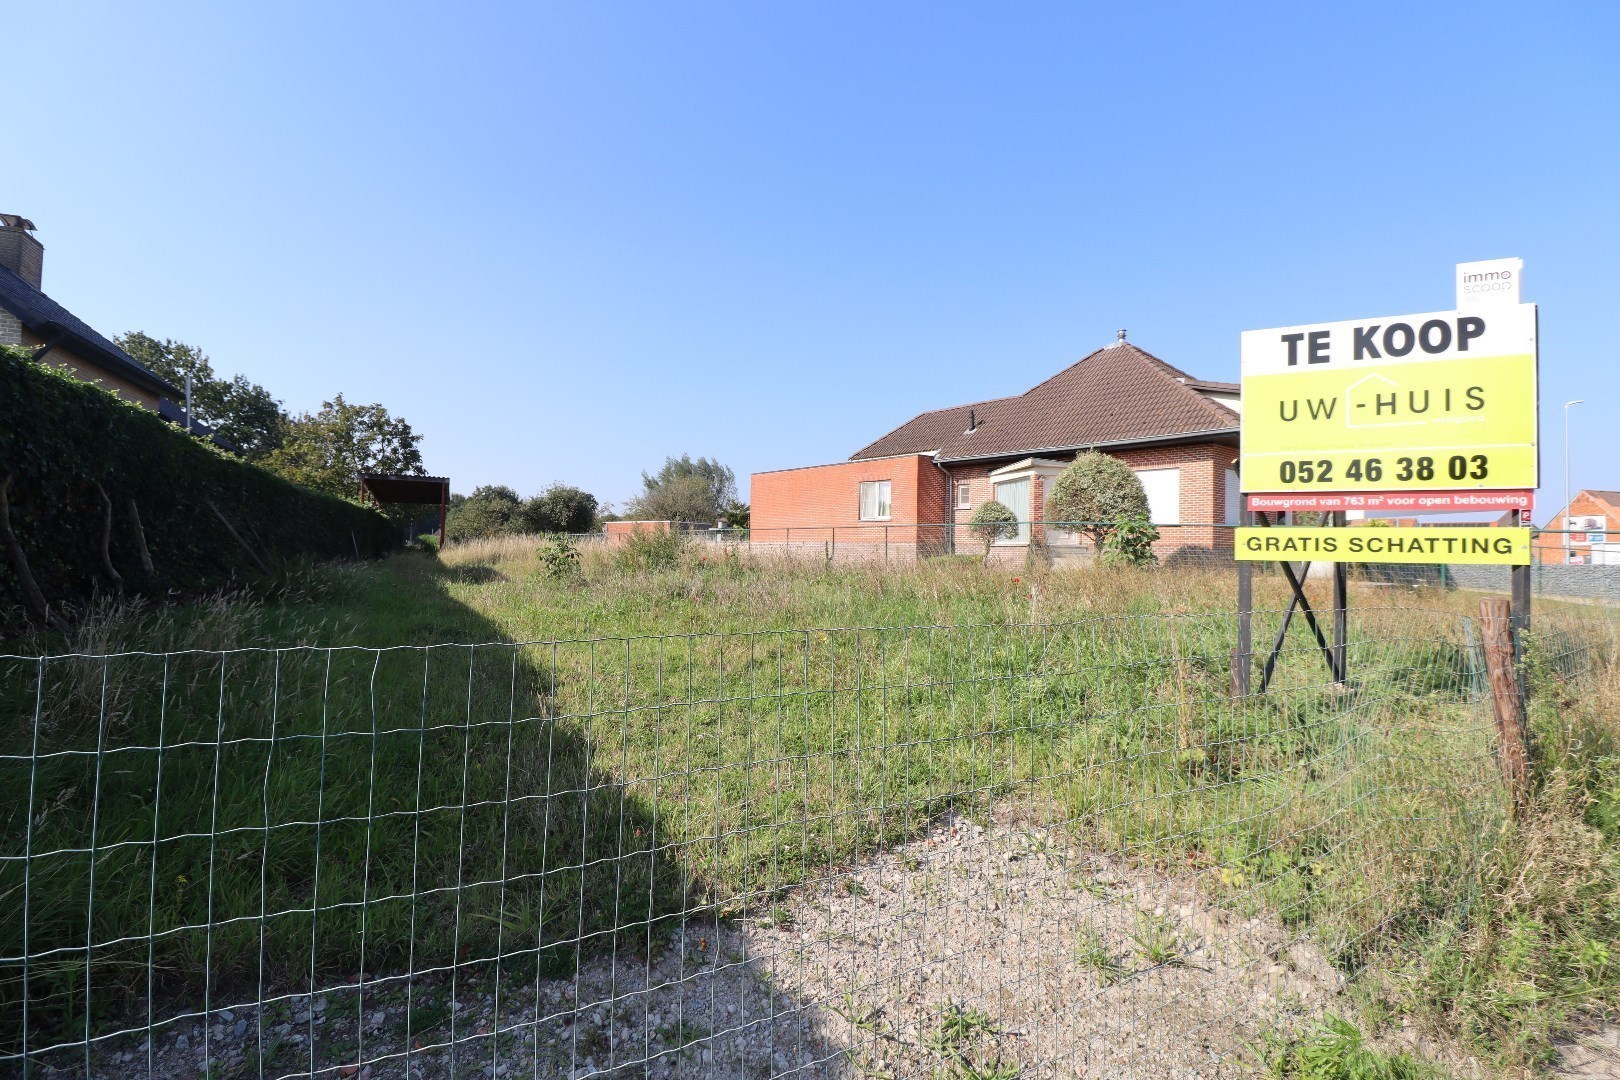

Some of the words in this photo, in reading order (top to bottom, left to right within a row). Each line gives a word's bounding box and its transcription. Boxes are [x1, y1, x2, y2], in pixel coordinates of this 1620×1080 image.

[1463, 270, 1511, 284] immo
[1281, 330, 1330, 366] TE
[1353, 316, 1486, 361] KOOP
[1279, 460, 1333, 484] 052
[1345, 458, 1383, 482] 46
[1396, 456, 1434, 481] 38
[1448, 454, 1488, 480] 03
[1251, 497, 1316, 508] Bouwgrond
[1319, 498, 1341, 506] van
[1343, 496, 1365, 506] 763
[1386, 496, 1415, 506] voor
[1418, 496, 1451, 506] open
[1453, 495, 1528, 506] bebouwing
[1246, 536, 1338, 552] GRATIS
[1348, 536, 1513, 555] SCHATTING
